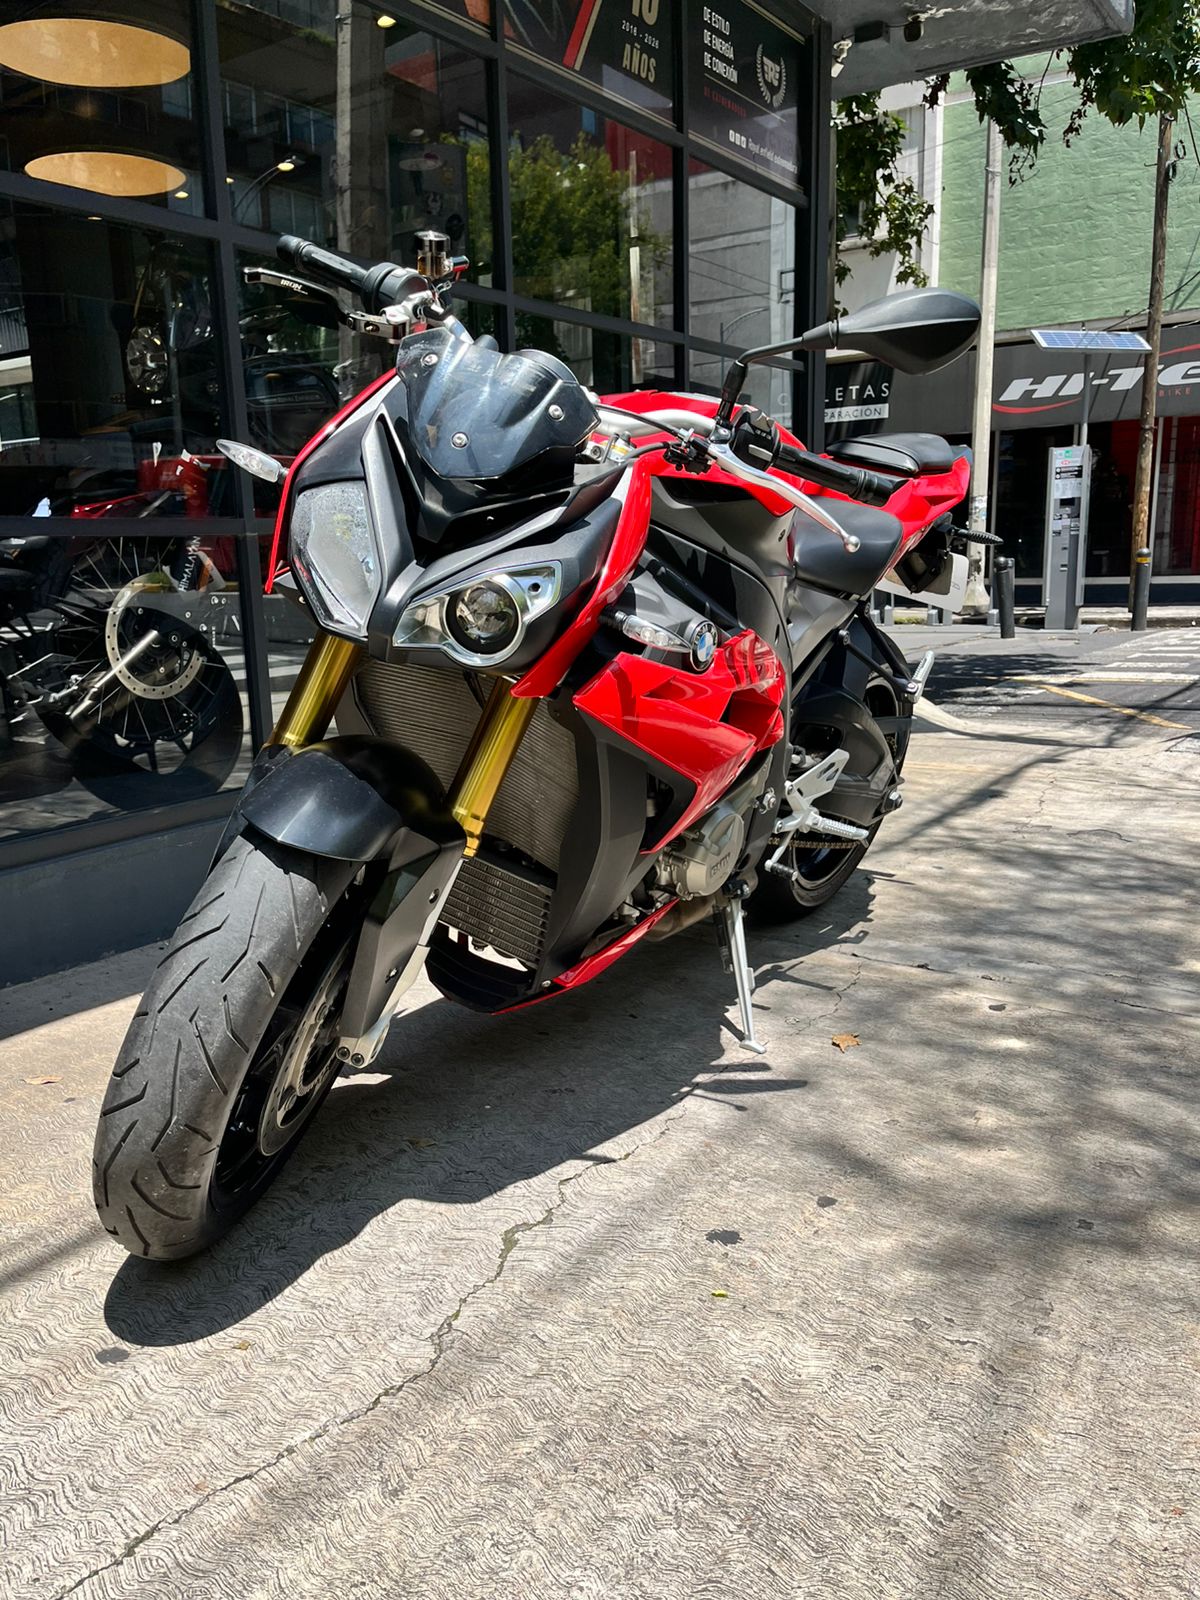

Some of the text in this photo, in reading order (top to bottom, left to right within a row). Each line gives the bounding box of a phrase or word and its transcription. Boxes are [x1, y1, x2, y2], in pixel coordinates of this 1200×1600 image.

[703, 6, 731, 36] DE ESTILO
[703, 29, 711, 46] DE
[622, 42, 657, 83] AÑOS
[703, 51, 712, 69] DE
[280, 279, 303, 290] IRON
[1158, 386, 1193, 398] BIKE
